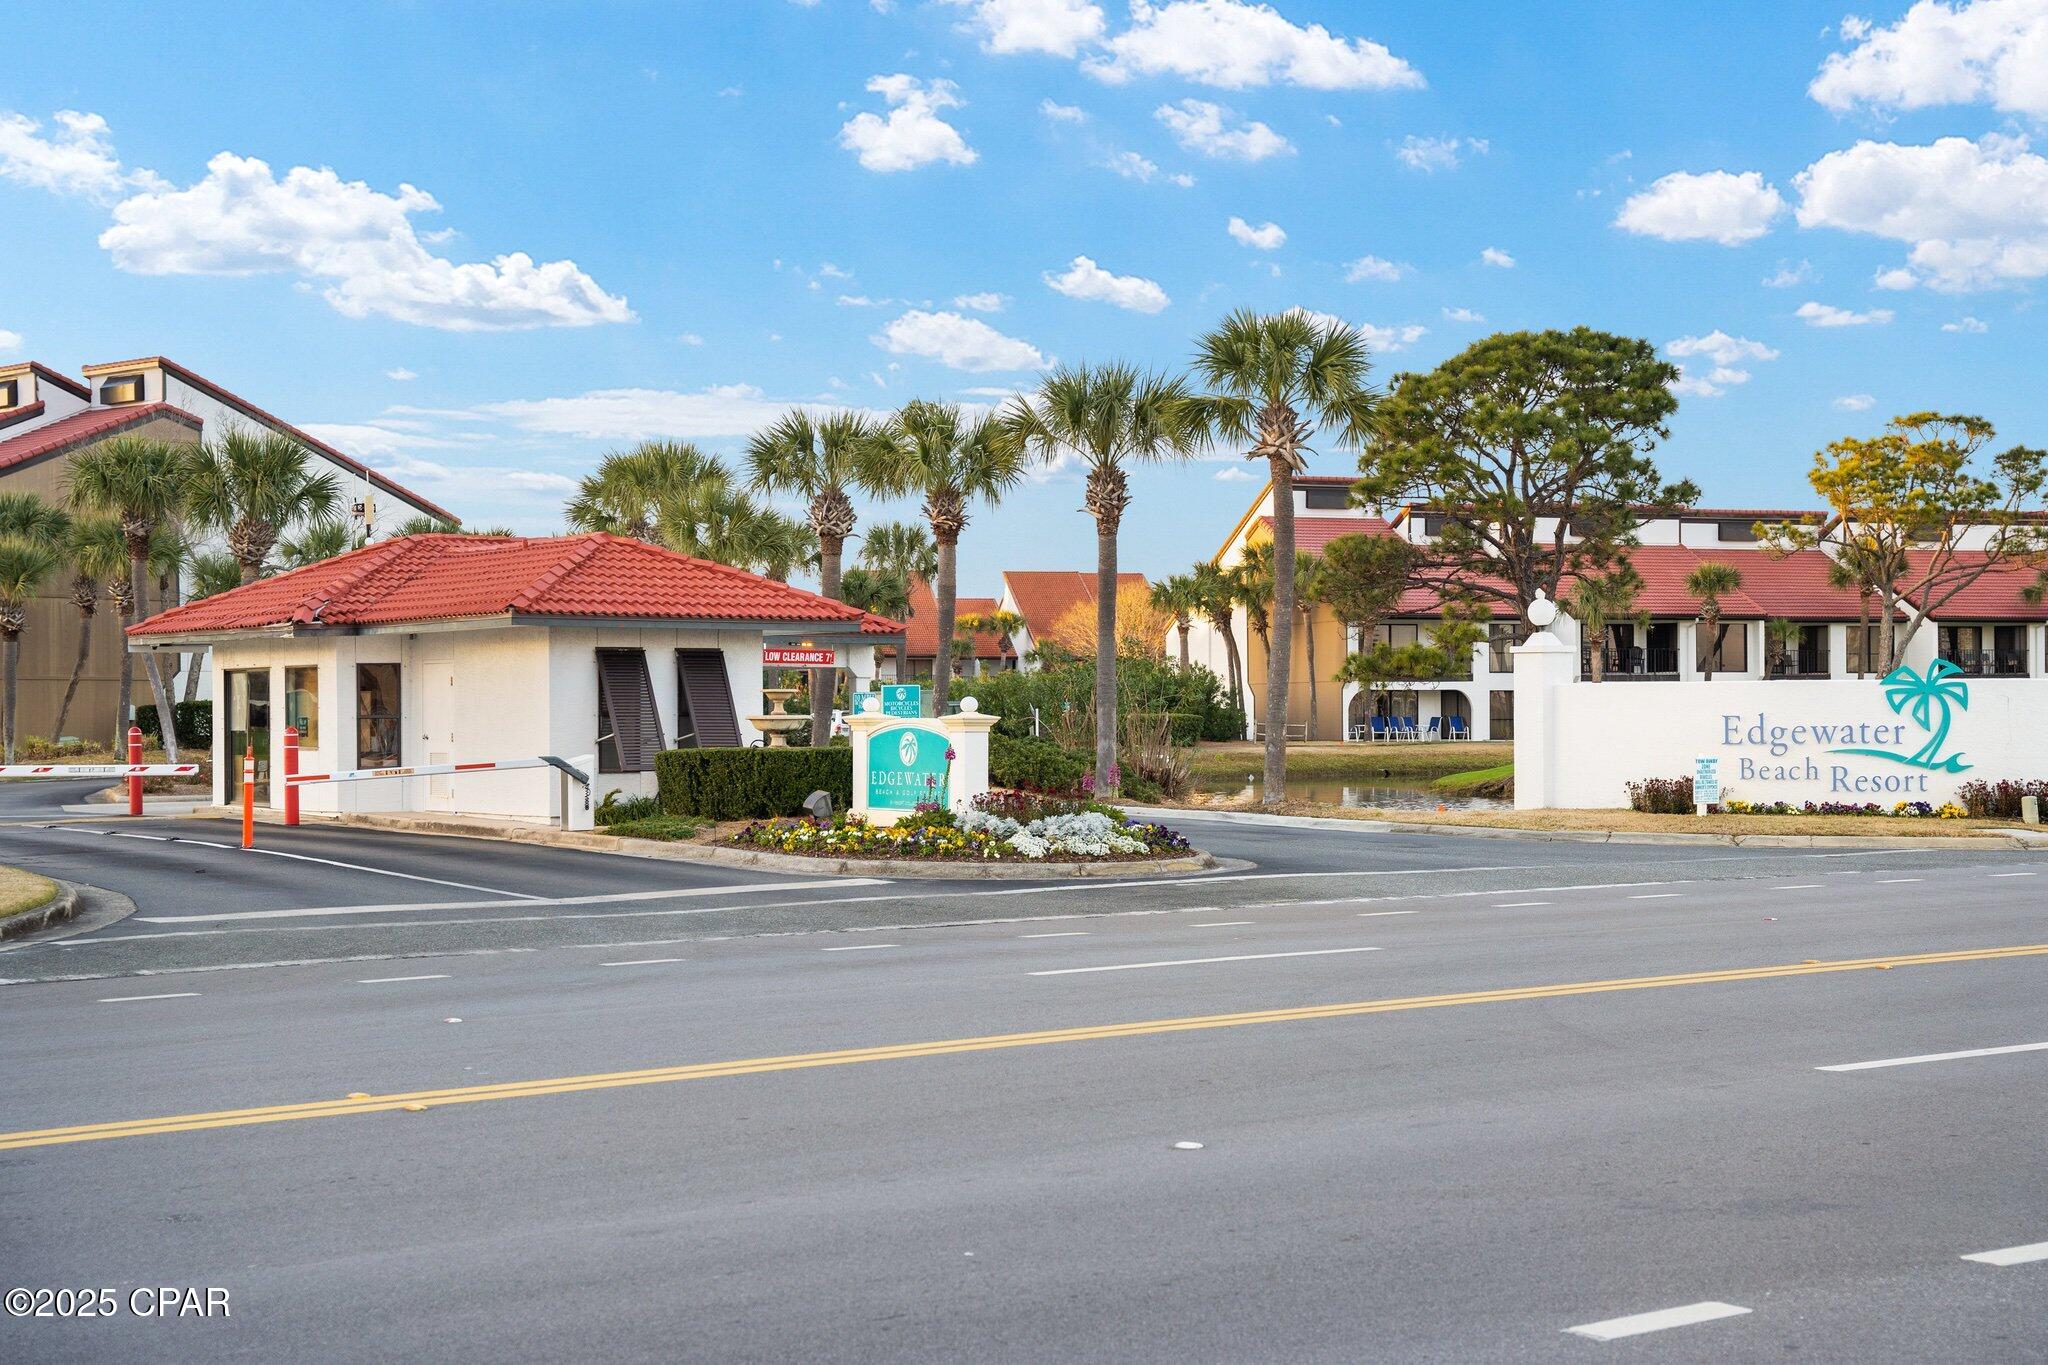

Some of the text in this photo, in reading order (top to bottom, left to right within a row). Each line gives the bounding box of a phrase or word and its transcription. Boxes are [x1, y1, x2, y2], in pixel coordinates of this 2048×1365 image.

[765, 652, 780, 661] LOW
[782, 652, 823, 662] CLEARANCE
[1721, 713, 1905, 757] Edgewater
[1739, 756, 1928, 793] Beach Resort
